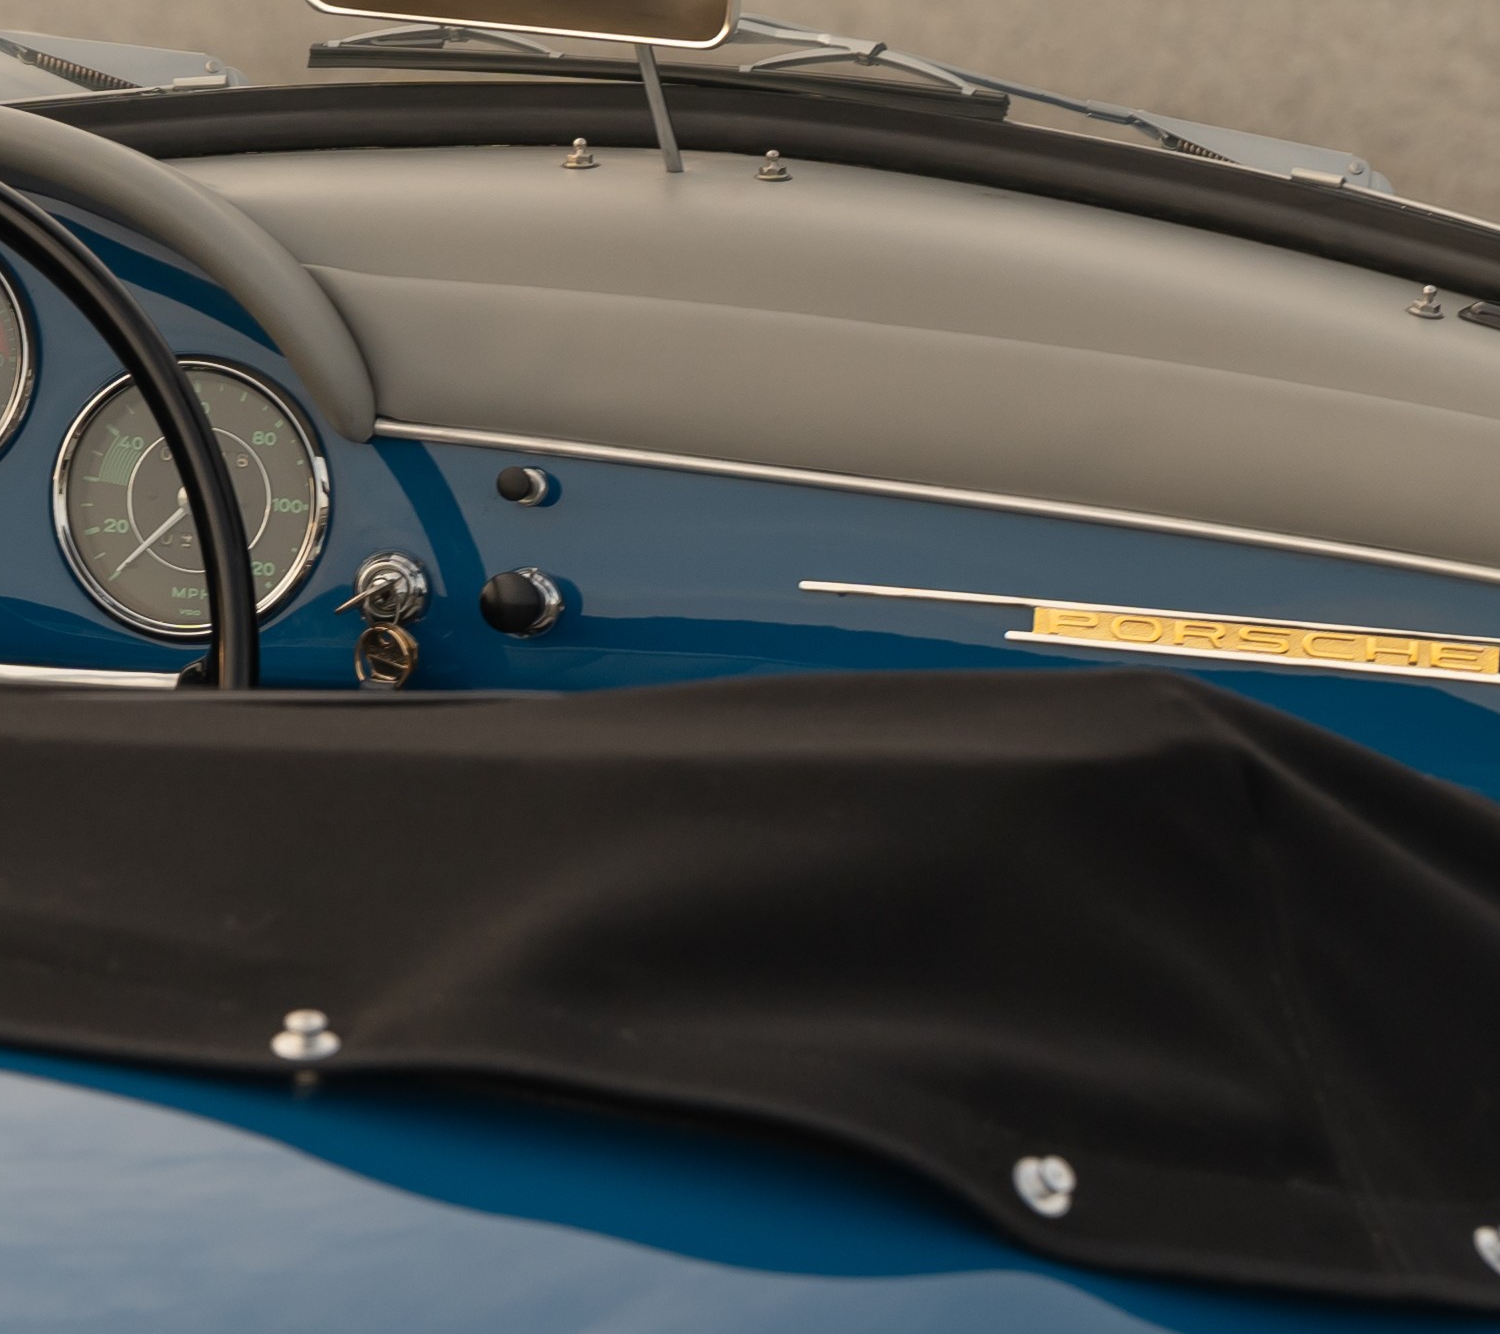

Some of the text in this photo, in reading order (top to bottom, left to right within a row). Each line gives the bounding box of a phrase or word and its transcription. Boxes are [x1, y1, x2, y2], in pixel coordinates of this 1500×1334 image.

[119, 436, 144, 450] 40
[252, 430, 277, 445] 80
[271, 497, 302, 513] 100
[103, 518, 129, 534] 20
[252, 560, 276, 576] 20
[1049, 608, 1485, 672] PORSCHE
